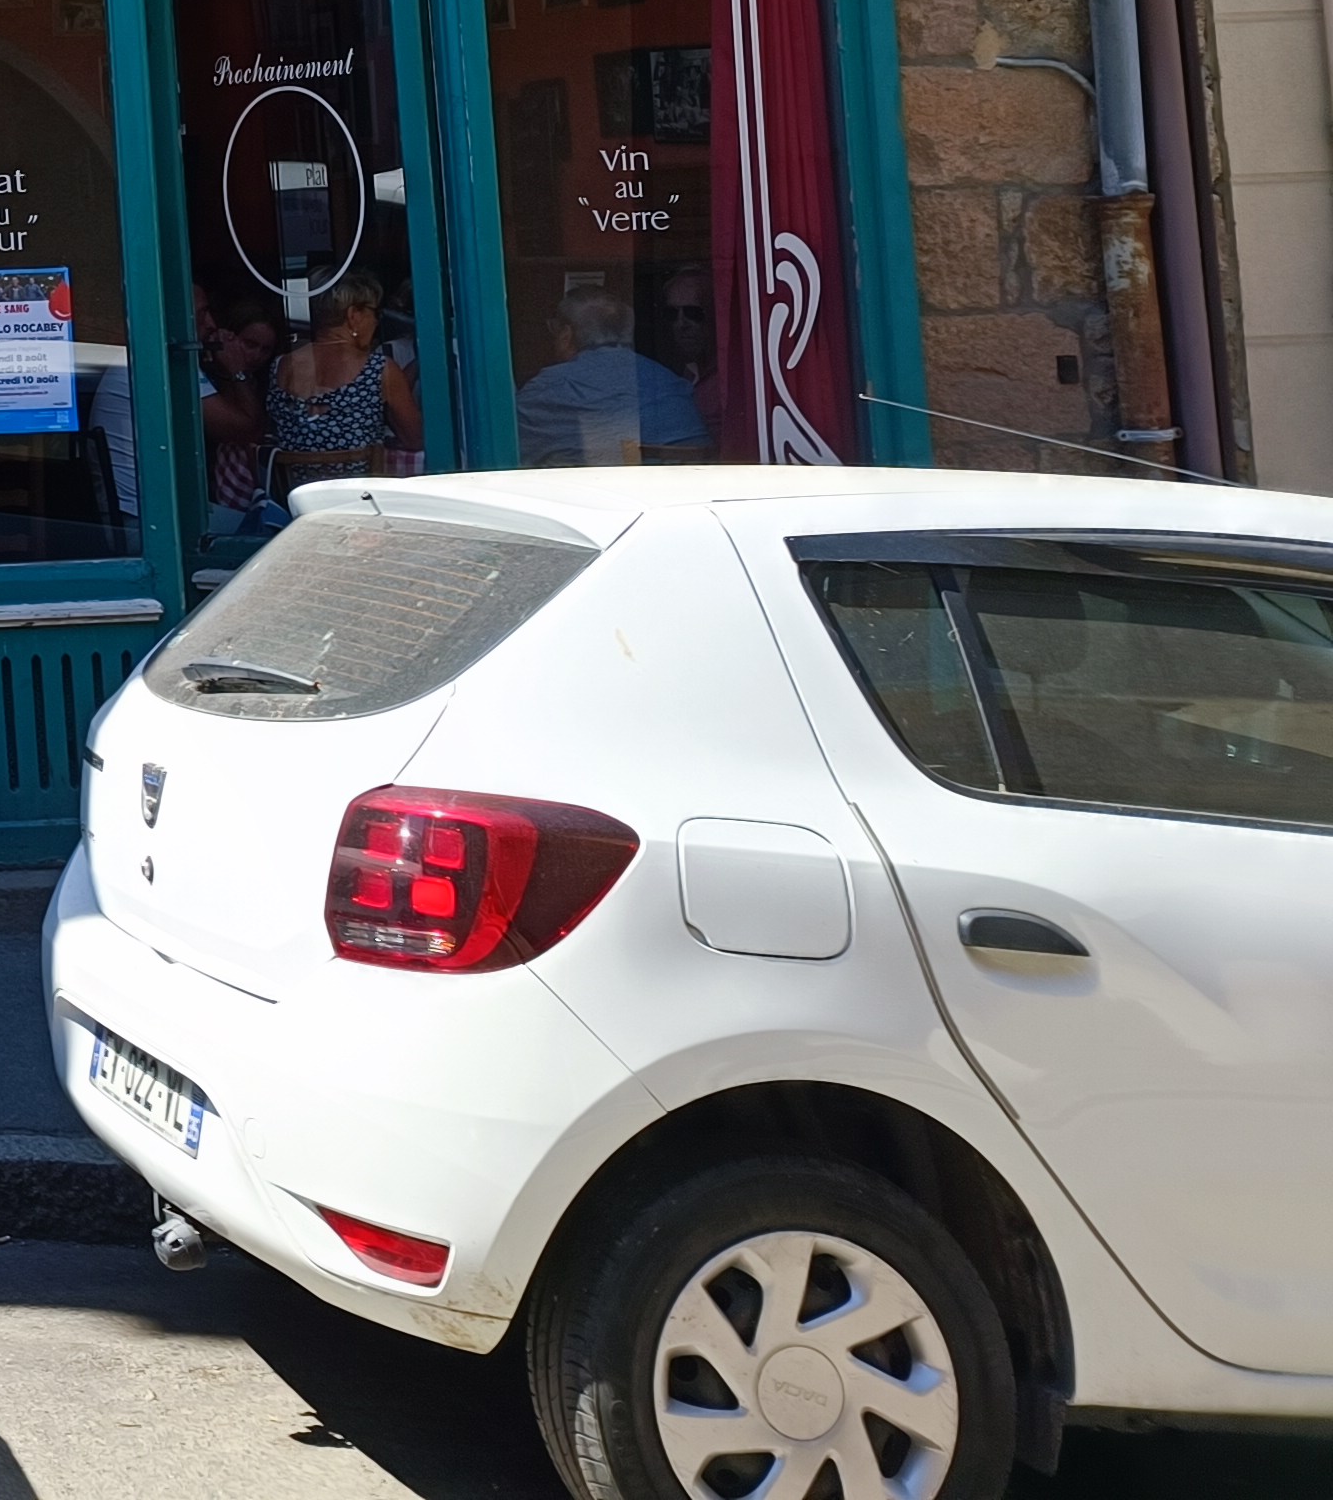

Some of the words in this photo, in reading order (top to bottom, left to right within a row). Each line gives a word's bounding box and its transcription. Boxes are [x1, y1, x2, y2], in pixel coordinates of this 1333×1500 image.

[213, 48, 353, 87] Prochainement
[599, 145, 649, 172] Vin
[615, 181, 643, 199] au
[4, 304, 30, 314] SANG
[14, 322, 64, 334] ROCABEY
[25, 353, 47, 362] août
[25, 365, 48, 373] août
[22, 375, 34, 384] 10
[36, 375, 59, 384] août
